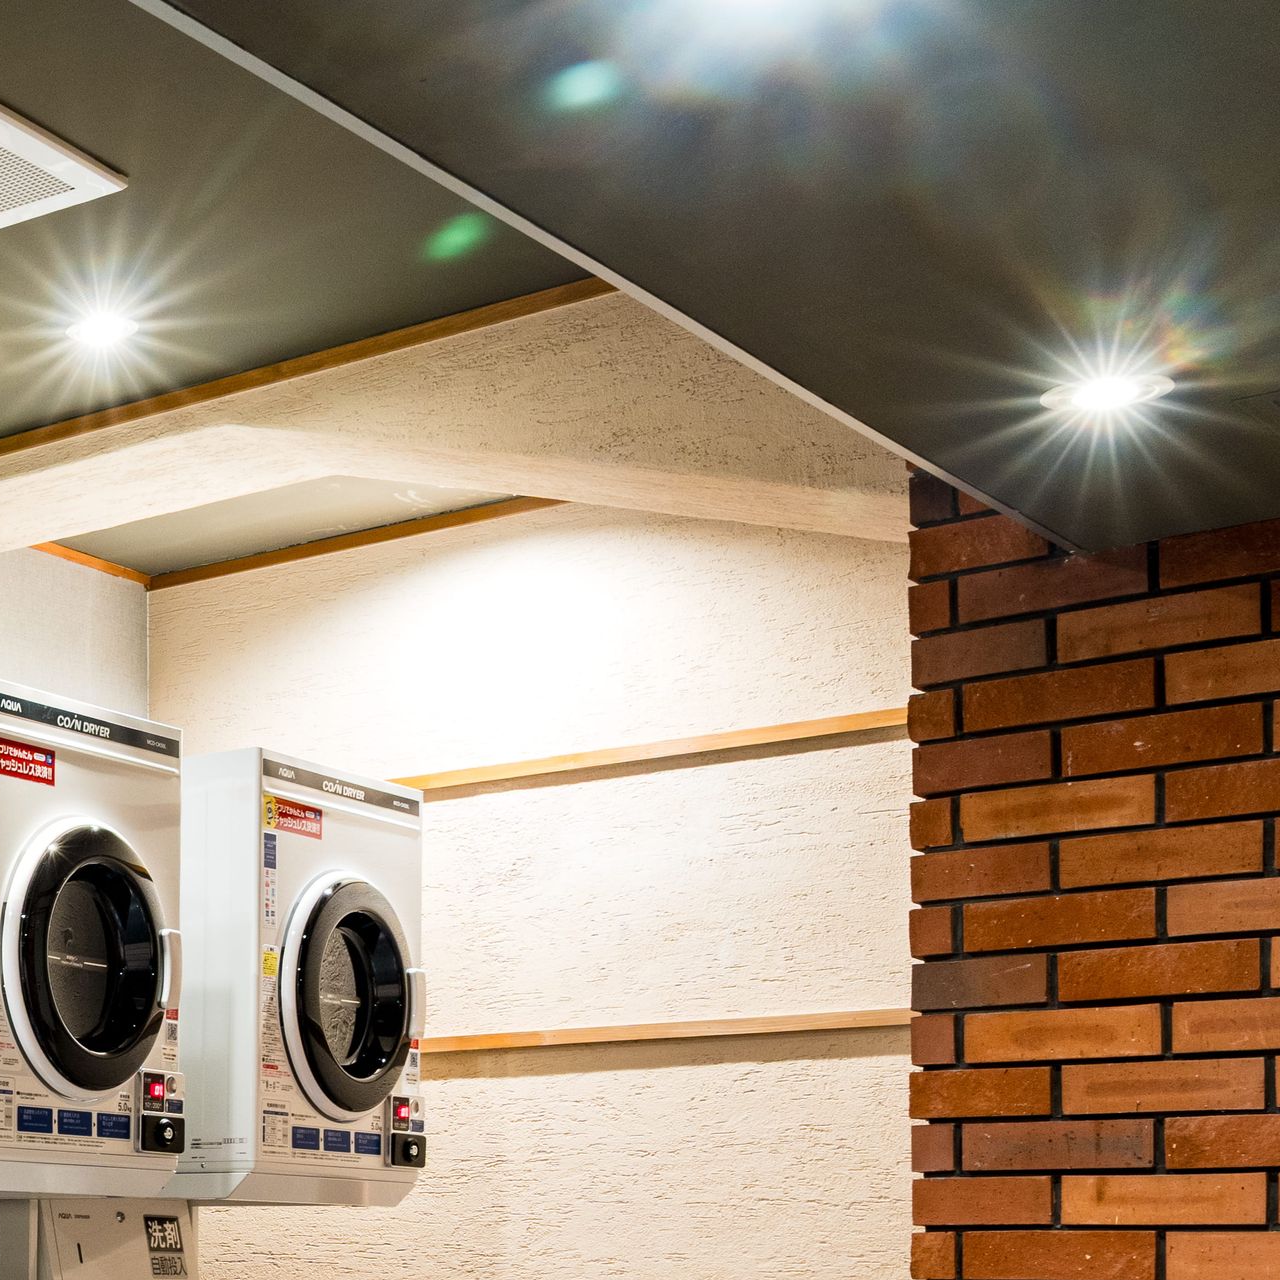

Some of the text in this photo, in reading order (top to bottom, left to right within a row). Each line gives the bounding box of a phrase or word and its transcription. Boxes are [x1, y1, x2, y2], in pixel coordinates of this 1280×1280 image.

[0, 699, 22, 713] AQUA
[83, 722, 110, 738] DRYER
[279, 767, 296, 779] AQUA
[343, 787, 365, 800] DRYER
[148, 1220, 181, 1249] 洗剤
[152, 1256, 187, 1276] 自動投入
